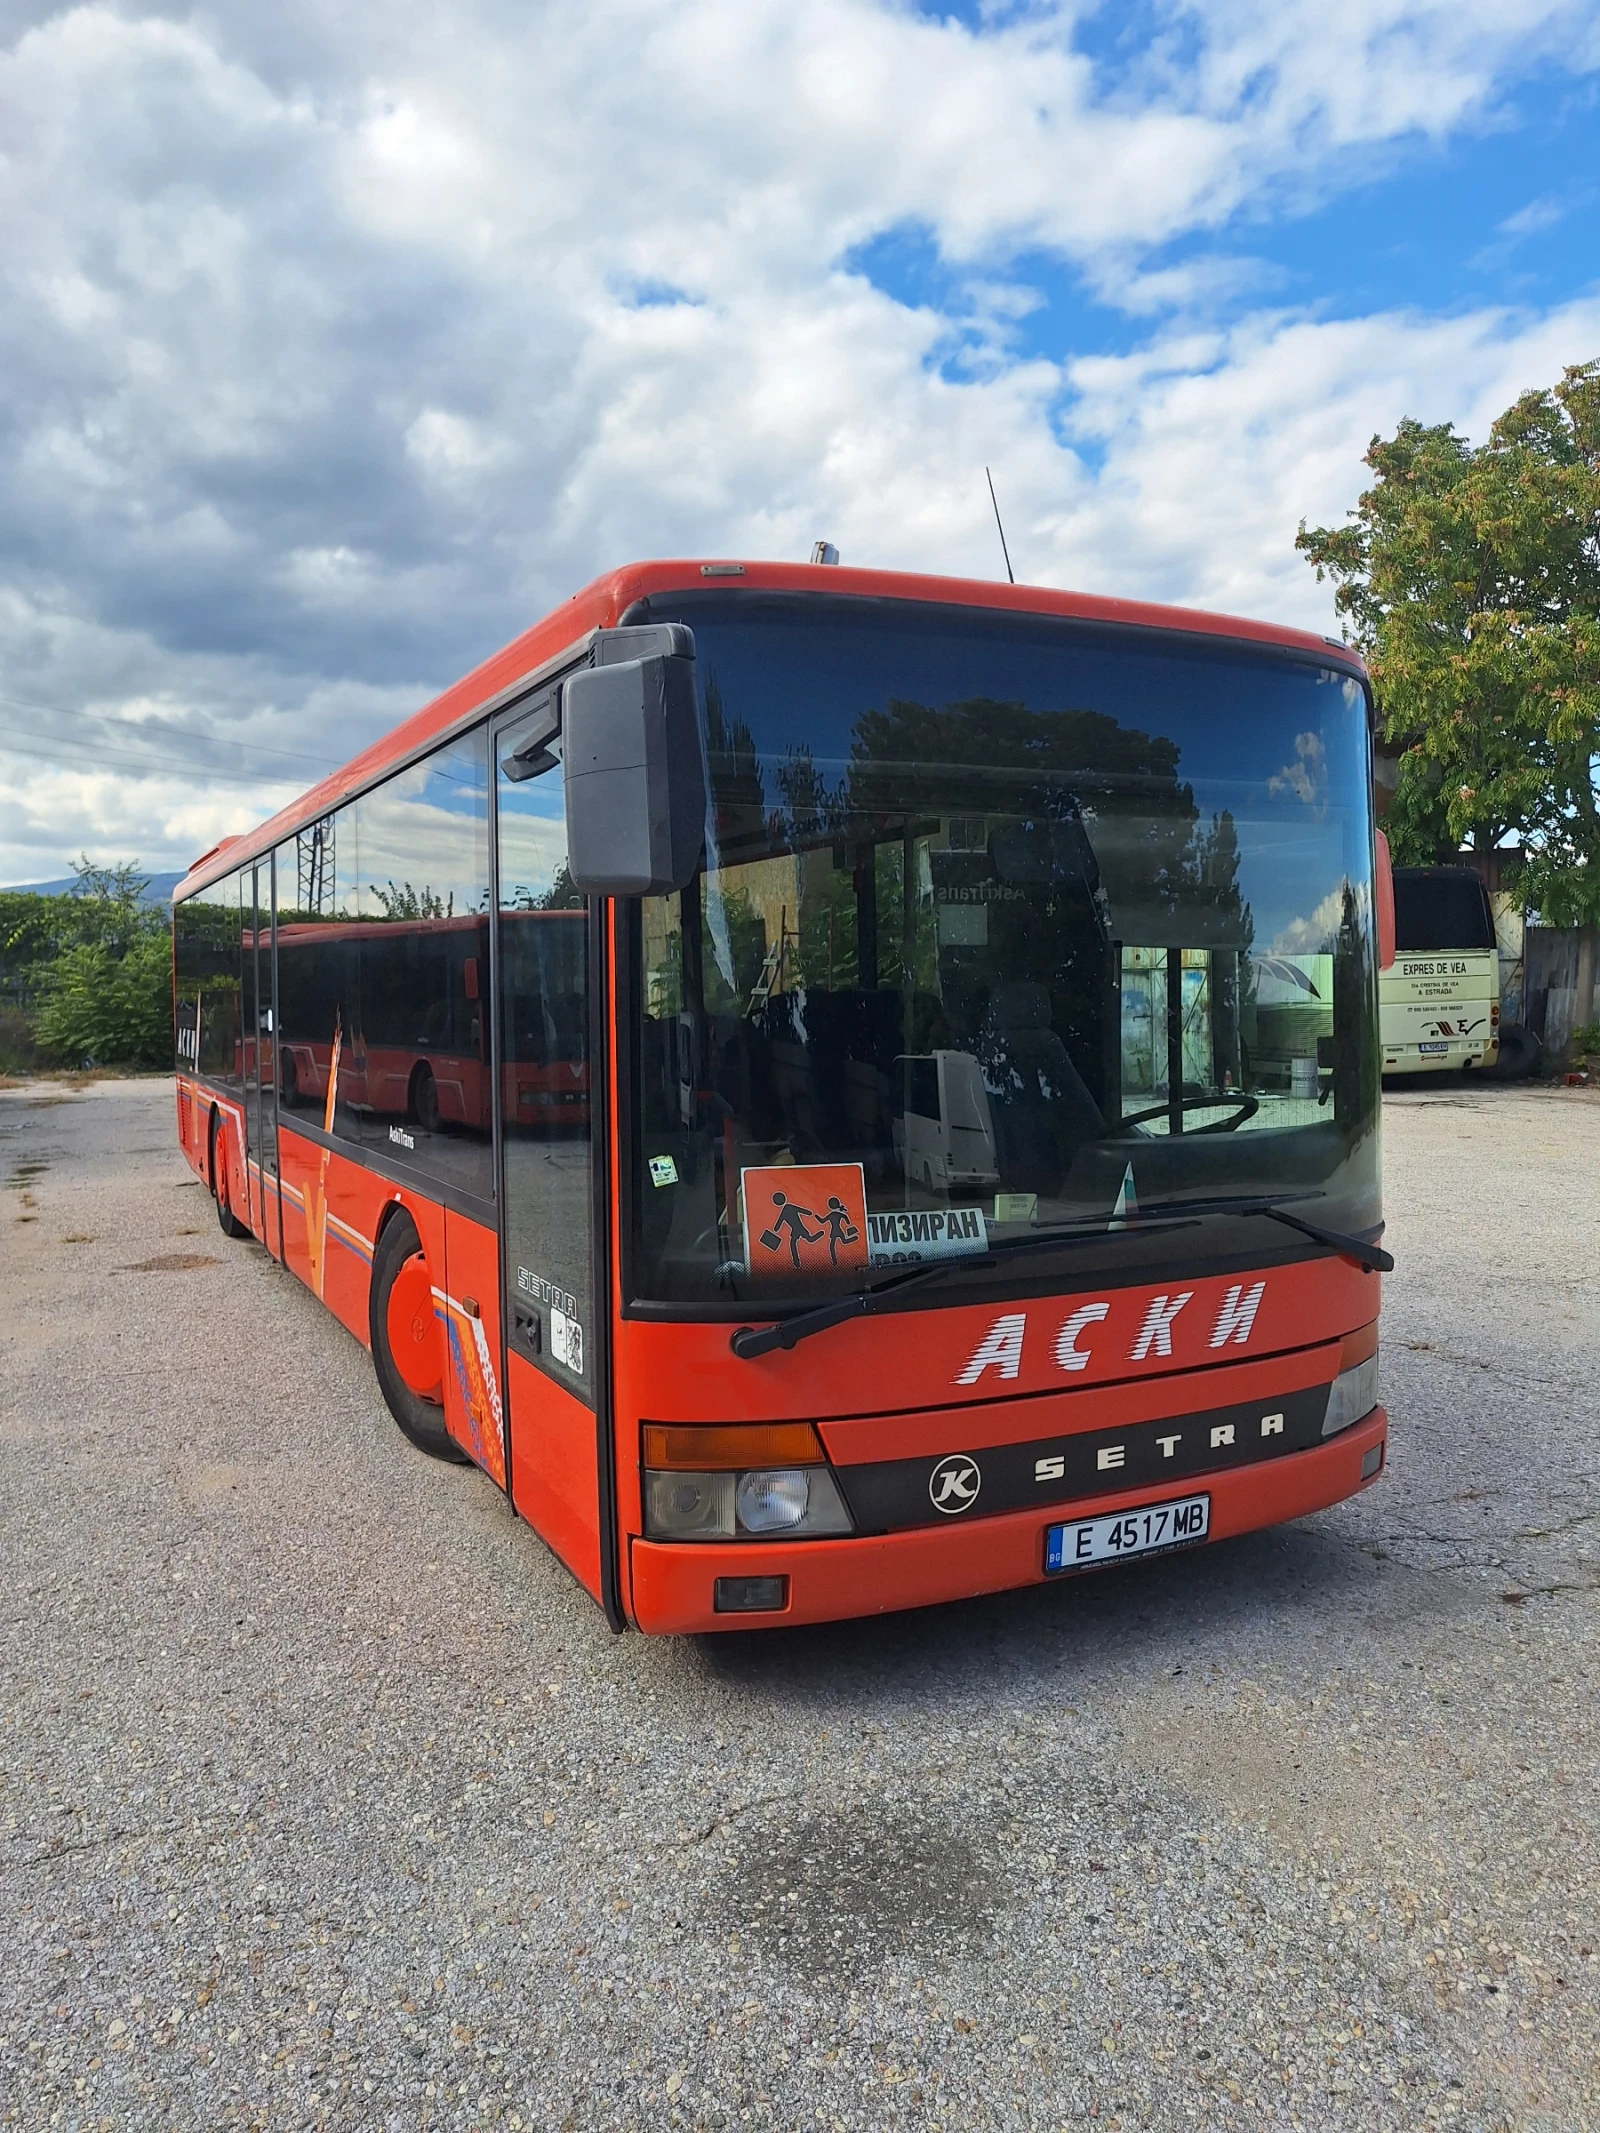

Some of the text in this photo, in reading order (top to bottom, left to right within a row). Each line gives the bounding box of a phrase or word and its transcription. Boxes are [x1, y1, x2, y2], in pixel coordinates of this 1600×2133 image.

[1403, 962, 1467, 976] EXPRES DE VEA
[1425, 988, 1453, 996] ESTRADA
[517, 1265, 577, 1320] SETRA
[1035, 1413, 1284, 1482] SETRA
[1049, 1552, 1061, 1563] BG
